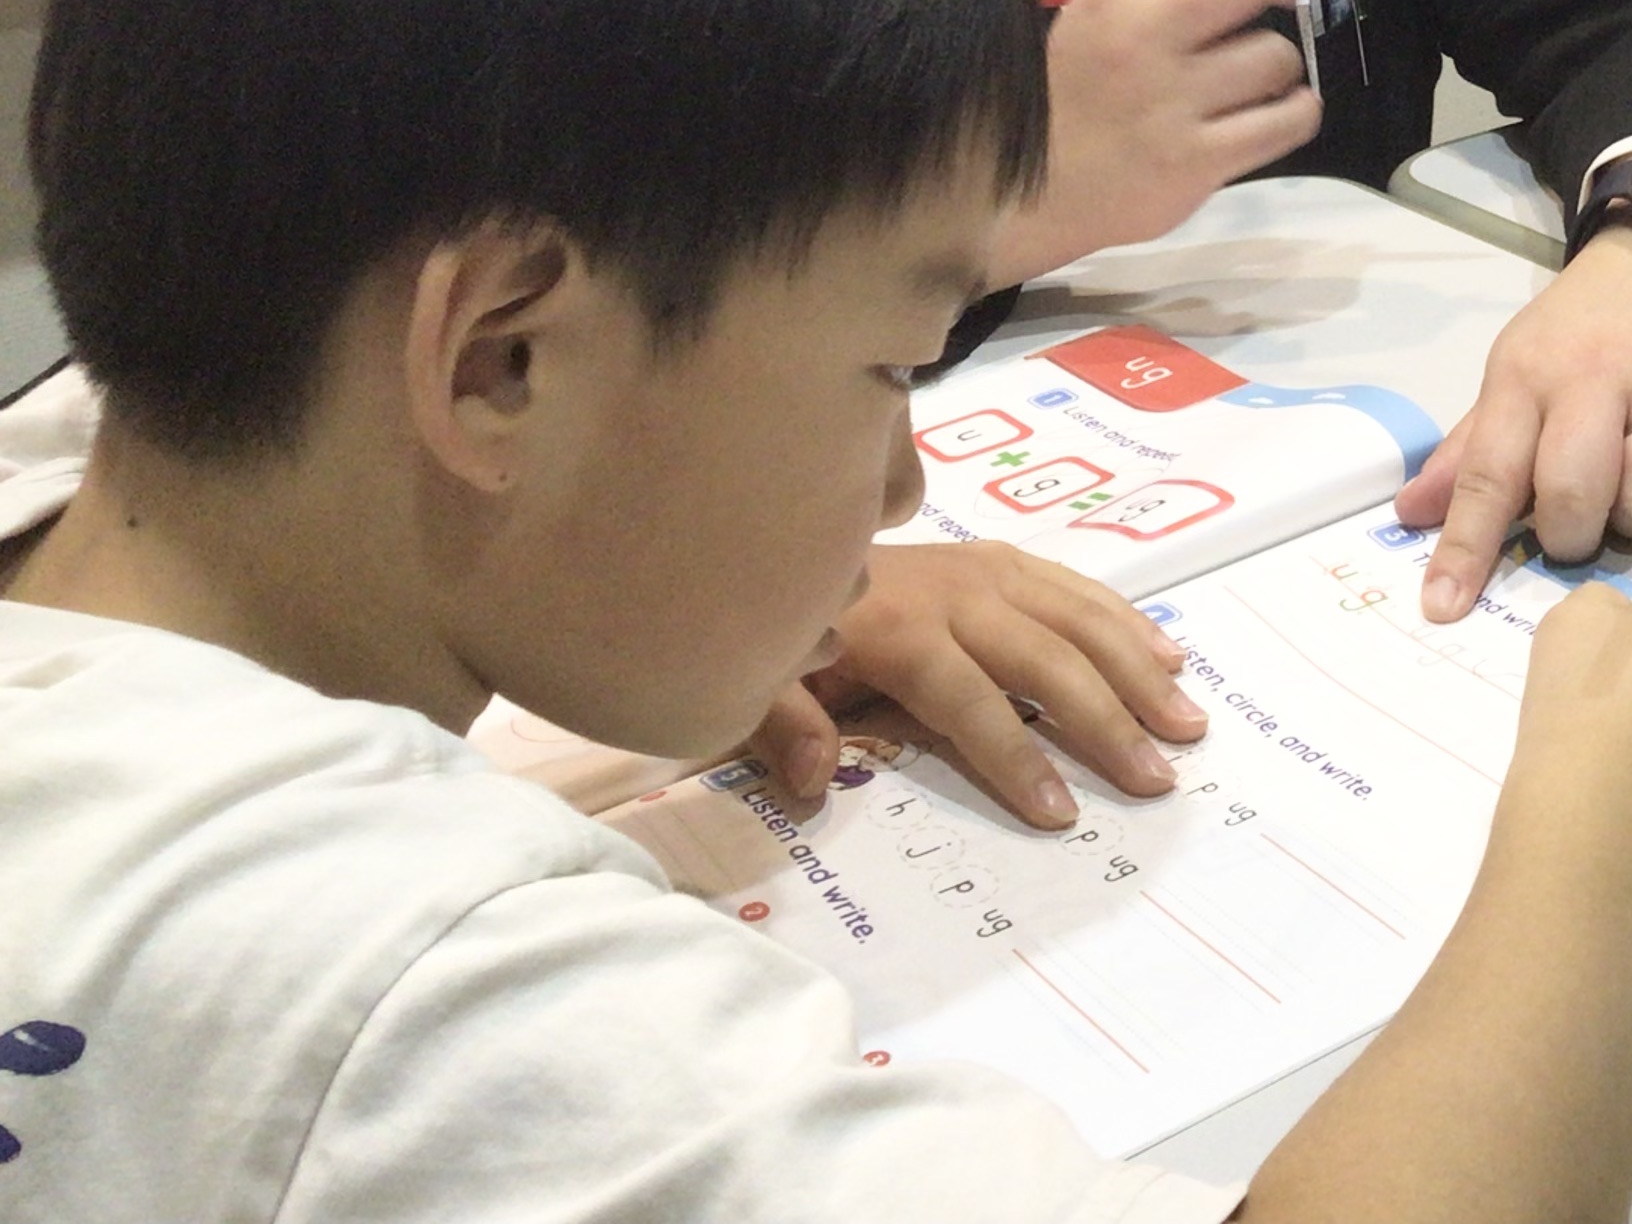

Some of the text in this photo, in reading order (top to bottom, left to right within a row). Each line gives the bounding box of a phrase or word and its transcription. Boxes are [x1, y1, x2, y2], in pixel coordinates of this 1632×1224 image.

[1120, 353, 1174, 389] ug
[1063, 406, 1108, 433] Listen
[1103, 431, 1140, 448] and
[1013, 478, 1062, 498] g
[932, 516, 981, 544] repea
[1476, 594, 1537, 636] nd wri
[1225, 691, 1278, 738] circle,
[1279, 735, 1329, 764] and
[1318, 761, 1373, 801] write.
[1224, 801, 1258, 827] ug
[741, 786, 799, 844] Listen
[788, 844, 829, 886] and
[821, 883, 874, 945] write.
[1063, 829, 1140, 883] p ug
[938, 879, 975, 896] p
[975, 909, 1014, 939] ug
